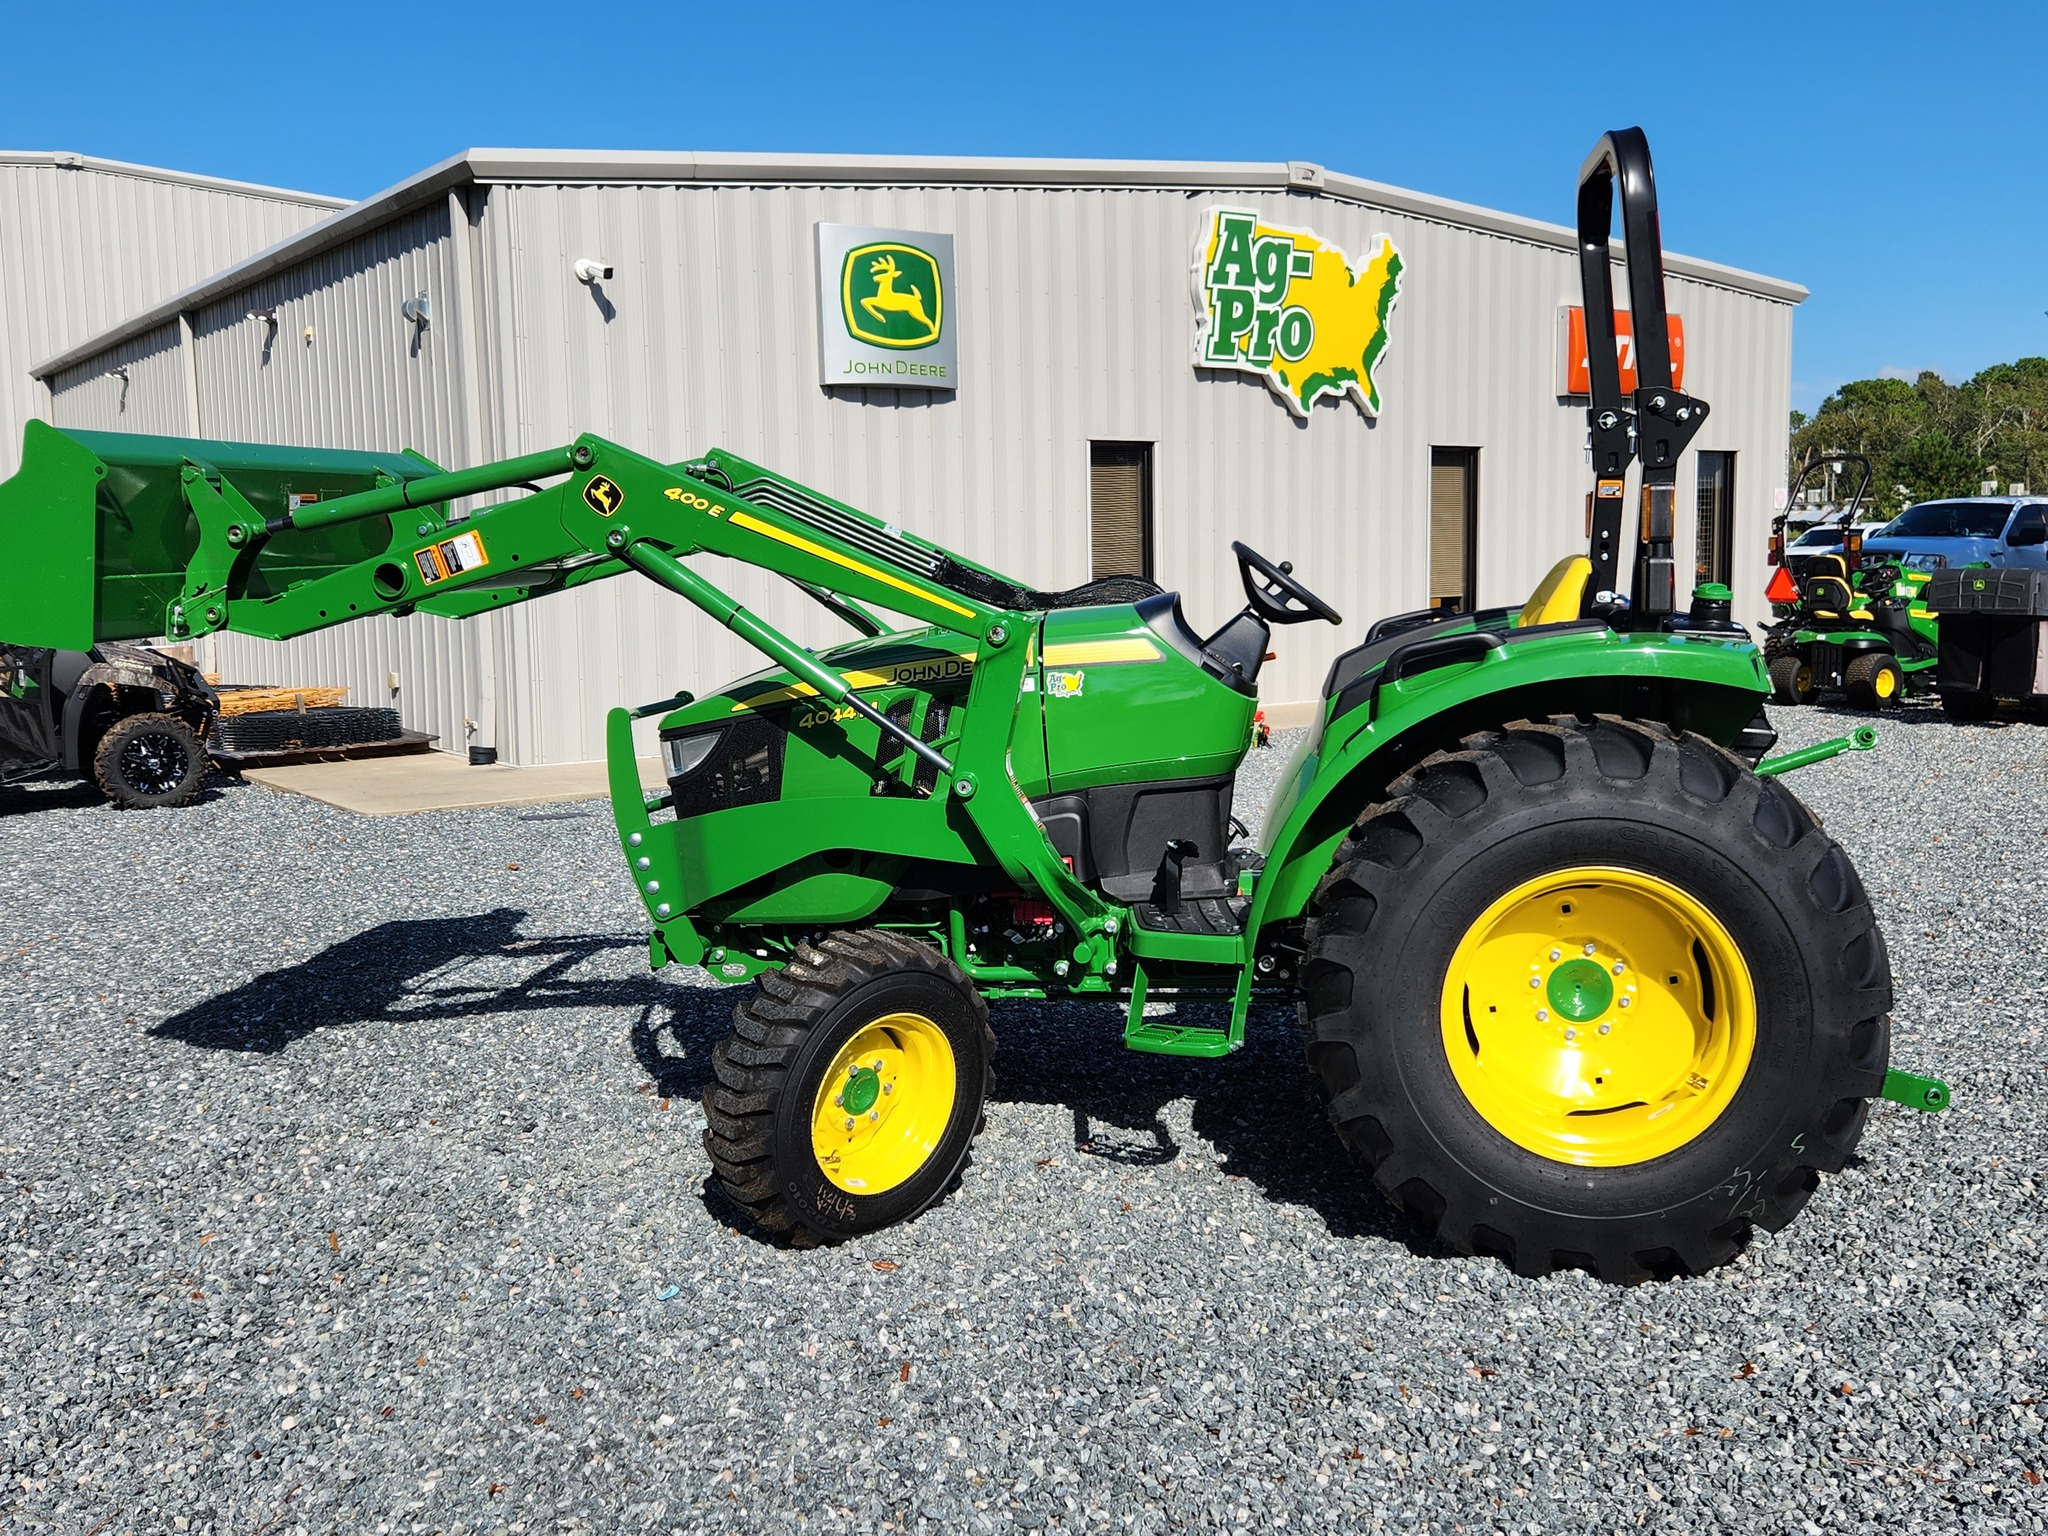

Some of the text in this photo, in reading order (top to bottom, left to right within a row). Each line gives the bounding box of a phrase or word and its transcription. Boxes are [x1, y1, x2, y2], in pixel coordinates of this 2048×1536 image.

[1207, 213, 1313, 305] Ag-
[1207, 289, 1314, 361] Pro
[843, 360, 947, 377] JOHN DEERE
[892, 665, 942, 684] JOHN
[1619, 827, 1751, 893] GALAXY
